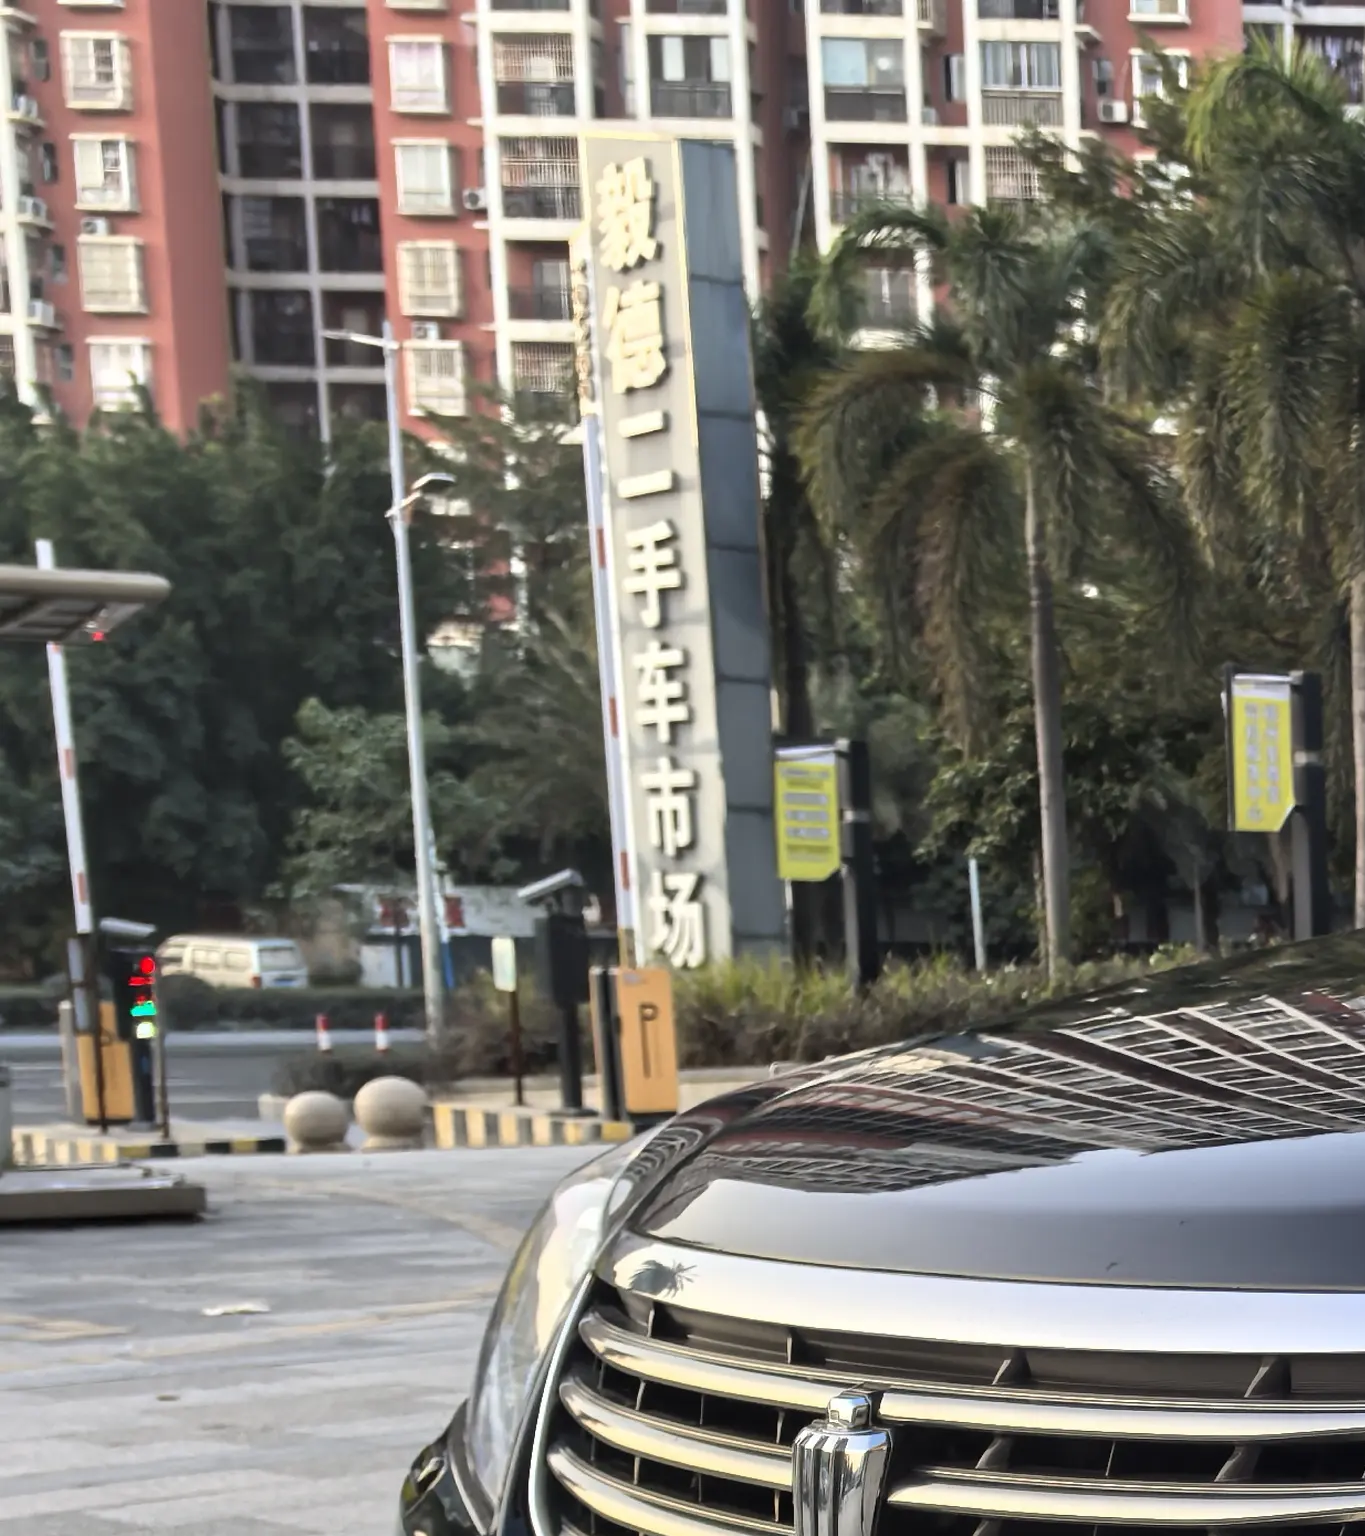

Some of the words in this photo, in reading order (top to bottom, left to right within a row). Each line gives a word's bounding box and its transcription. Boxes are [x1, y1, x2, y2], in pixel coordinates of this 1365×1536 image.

[595, 158, 707, 971] 毅德二手车市场
